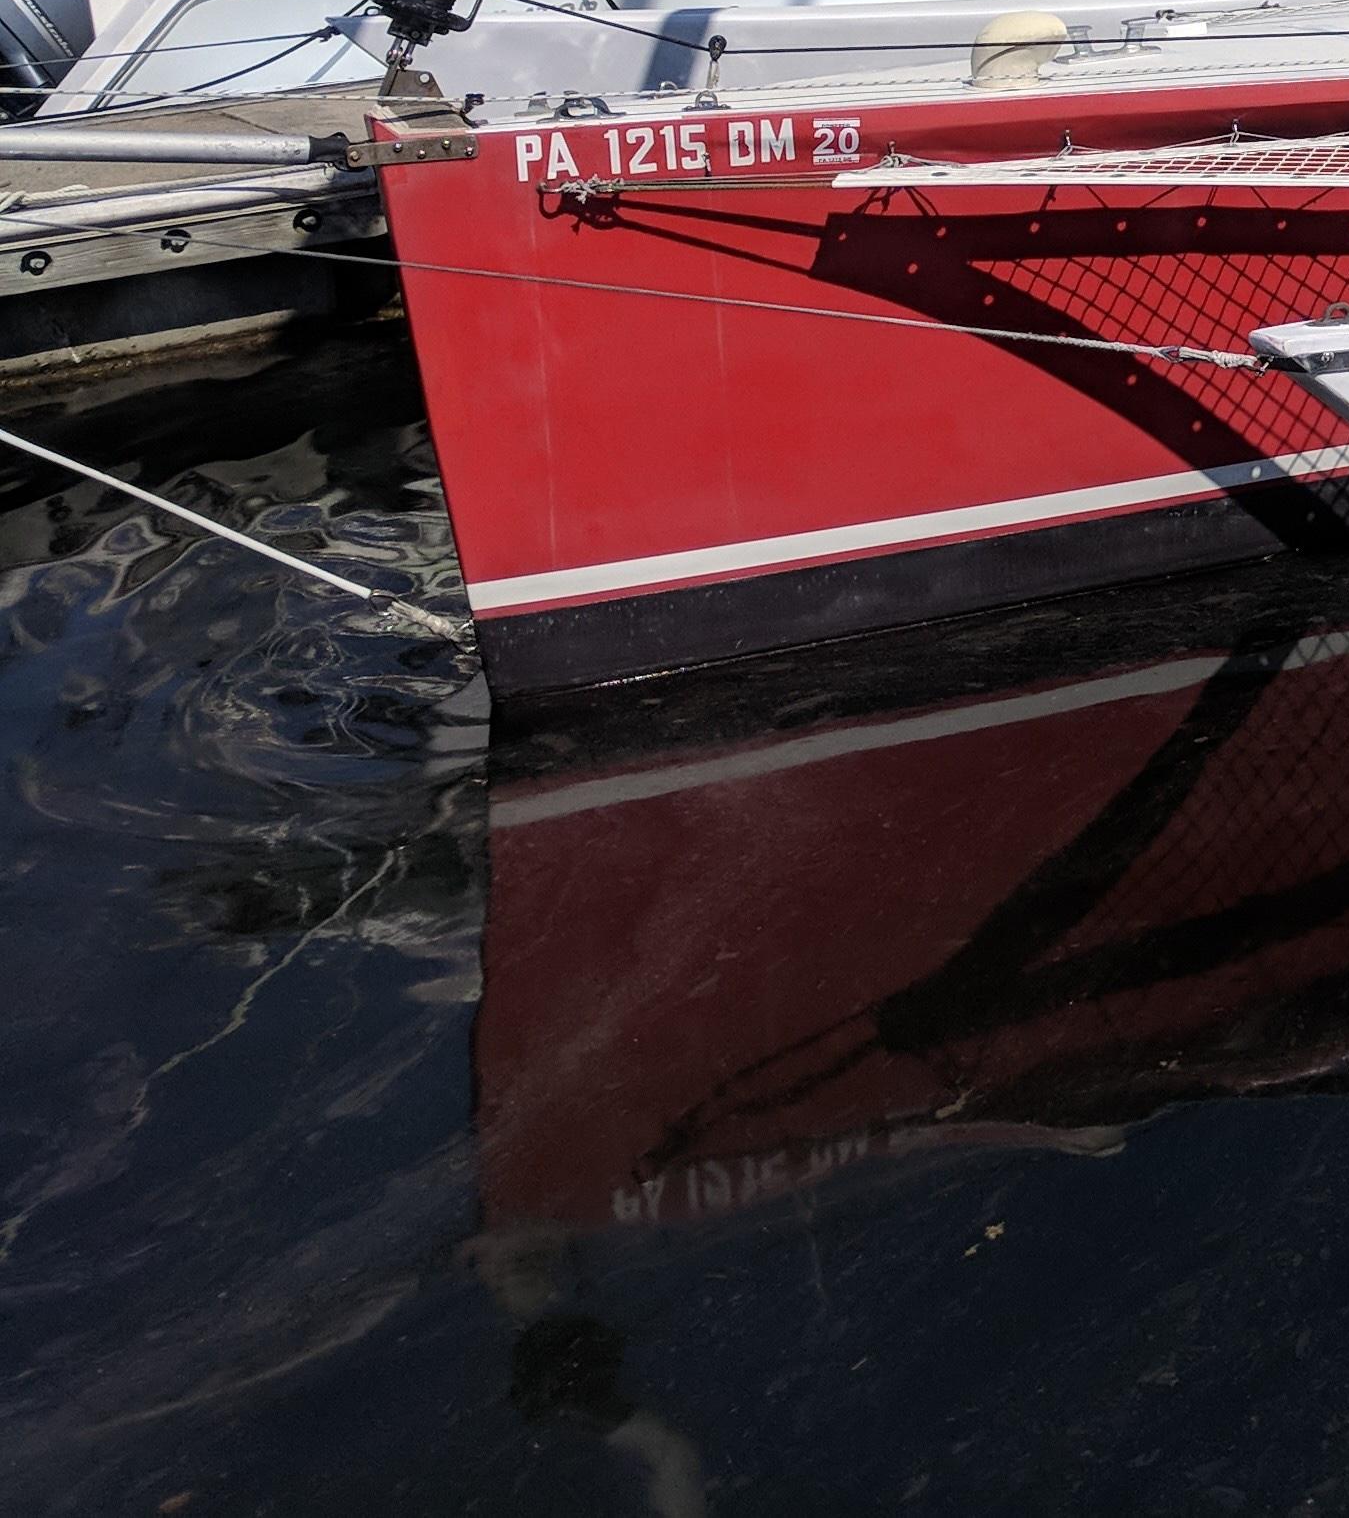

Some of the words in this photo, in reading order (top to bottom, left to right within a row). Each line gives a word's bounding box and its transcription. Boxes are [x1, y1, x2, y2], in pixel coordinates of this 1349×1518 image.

[516, 132, 579, 182] PA
[604, 124, 706, 174] 1215
[728, 118, 796, 167] DM
[813, 128, 859, 155] 20
